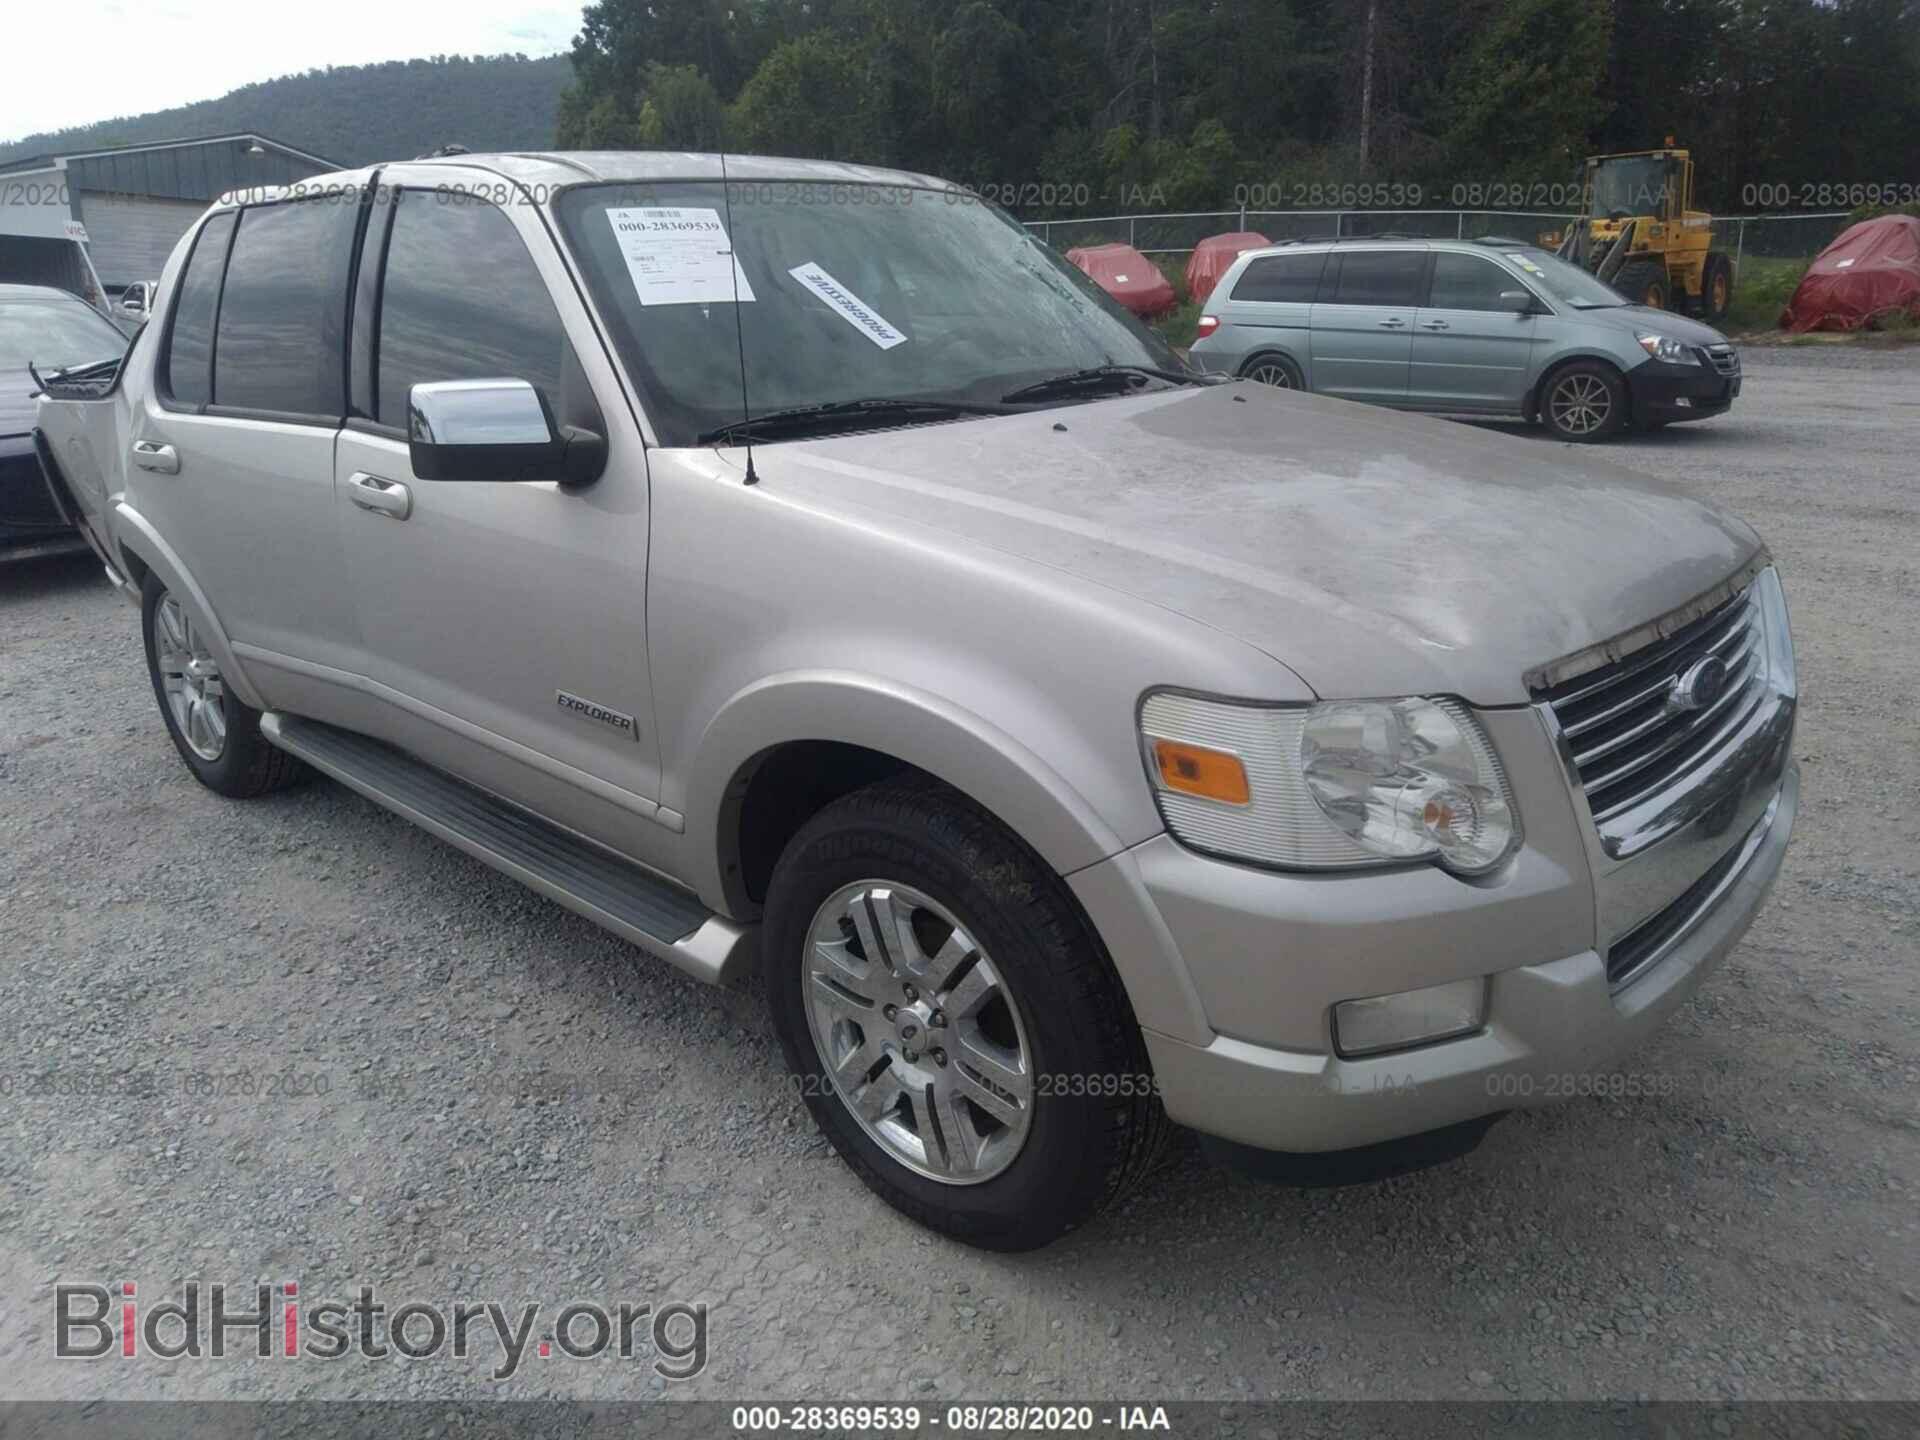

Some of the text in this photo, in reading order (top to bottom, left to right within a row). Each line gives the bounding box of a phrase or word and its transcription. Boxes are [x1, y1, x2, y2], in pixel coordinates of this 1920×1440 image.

[619, 221, 720, 232] 000-28369539
[805, 273, 897, 340] PROGRESSIVE
[557, 694, 631, 731] EXPLORER
